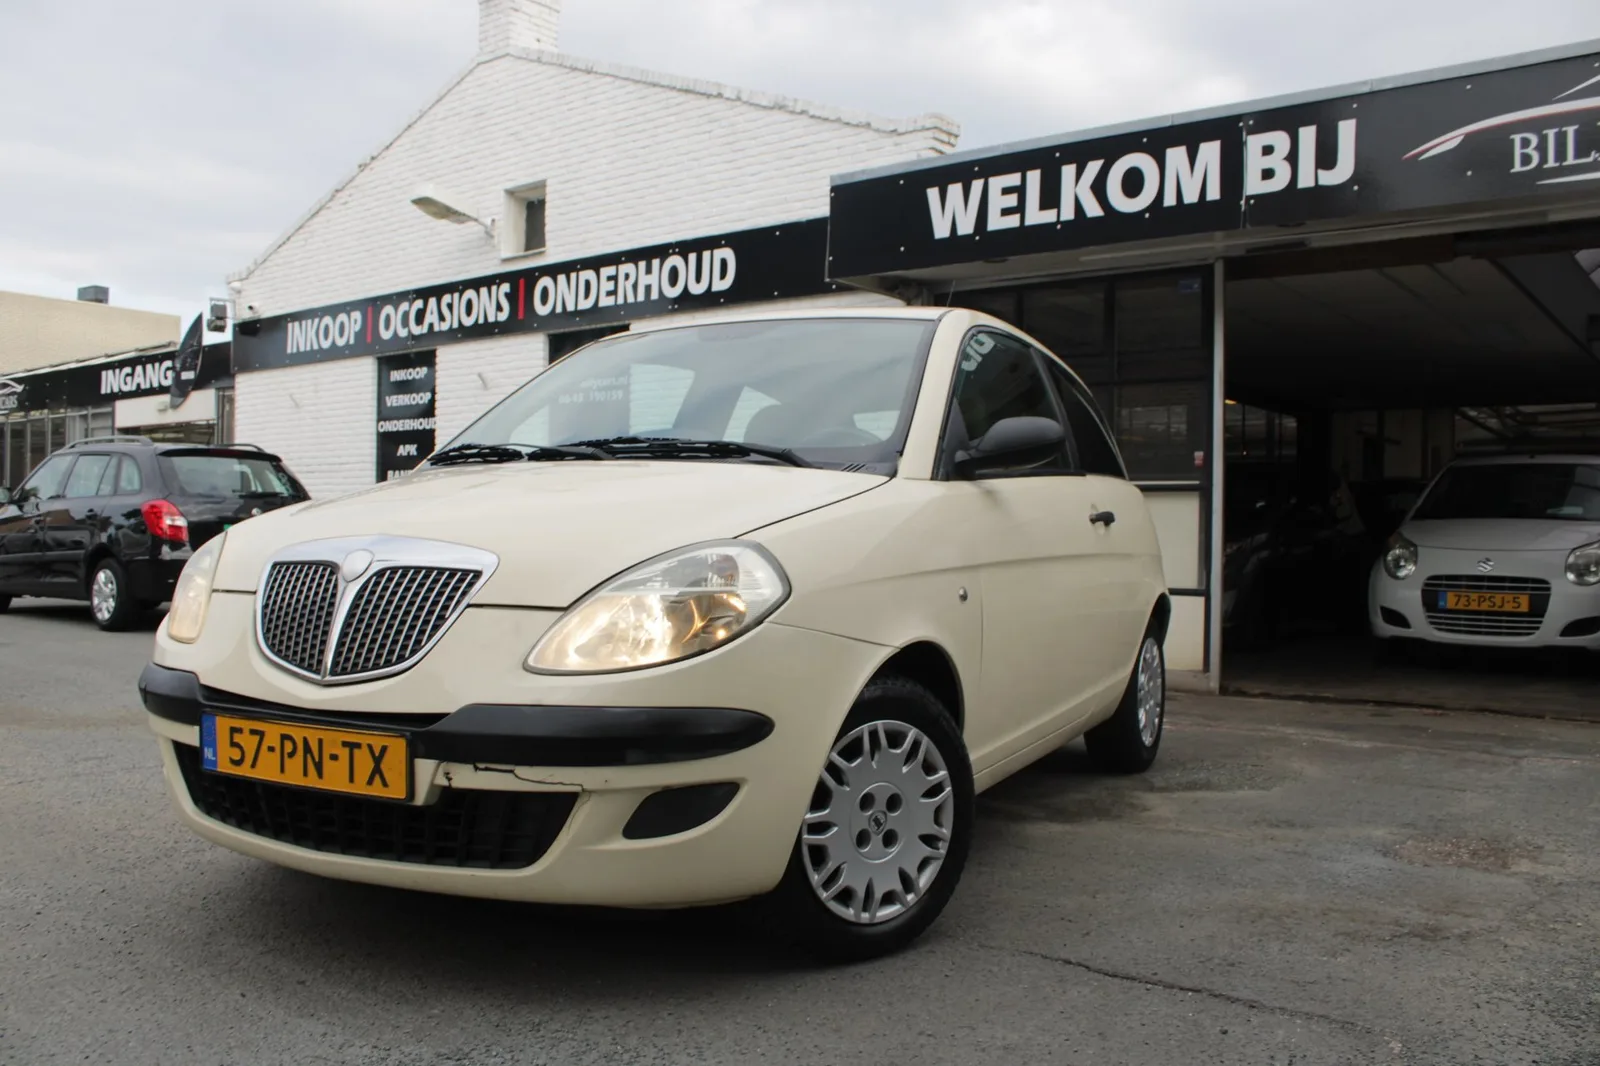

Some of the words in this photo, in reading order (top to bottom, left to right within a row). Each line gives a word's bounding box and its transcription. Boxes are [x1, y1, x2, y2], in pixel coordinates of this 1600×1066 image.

[1509, 124, 1600, 173] BIL
[926, 140, 1221, 239] WELKOM
[1245, 118, 1357, 197] BIJ
[286, 313, 362, 354] INKOOP
[378, 282, 511, 340] OCCASIONS
[533, 247, 737, 316] ONDERHOUD
[100, 360, 173, 395] INGANG
[389, 367, 428, 382] INKOOP
[385, 392, 432, 407] VERKOOP
[396, 444, 418, 456] APK
[387, 469, 415, 480] BAN
[1453, 594, 1522, 609] 73-PSJ-5
[204, 746, 216, 760] NL
[228, 726, 390, 788] 57-PN-TX
